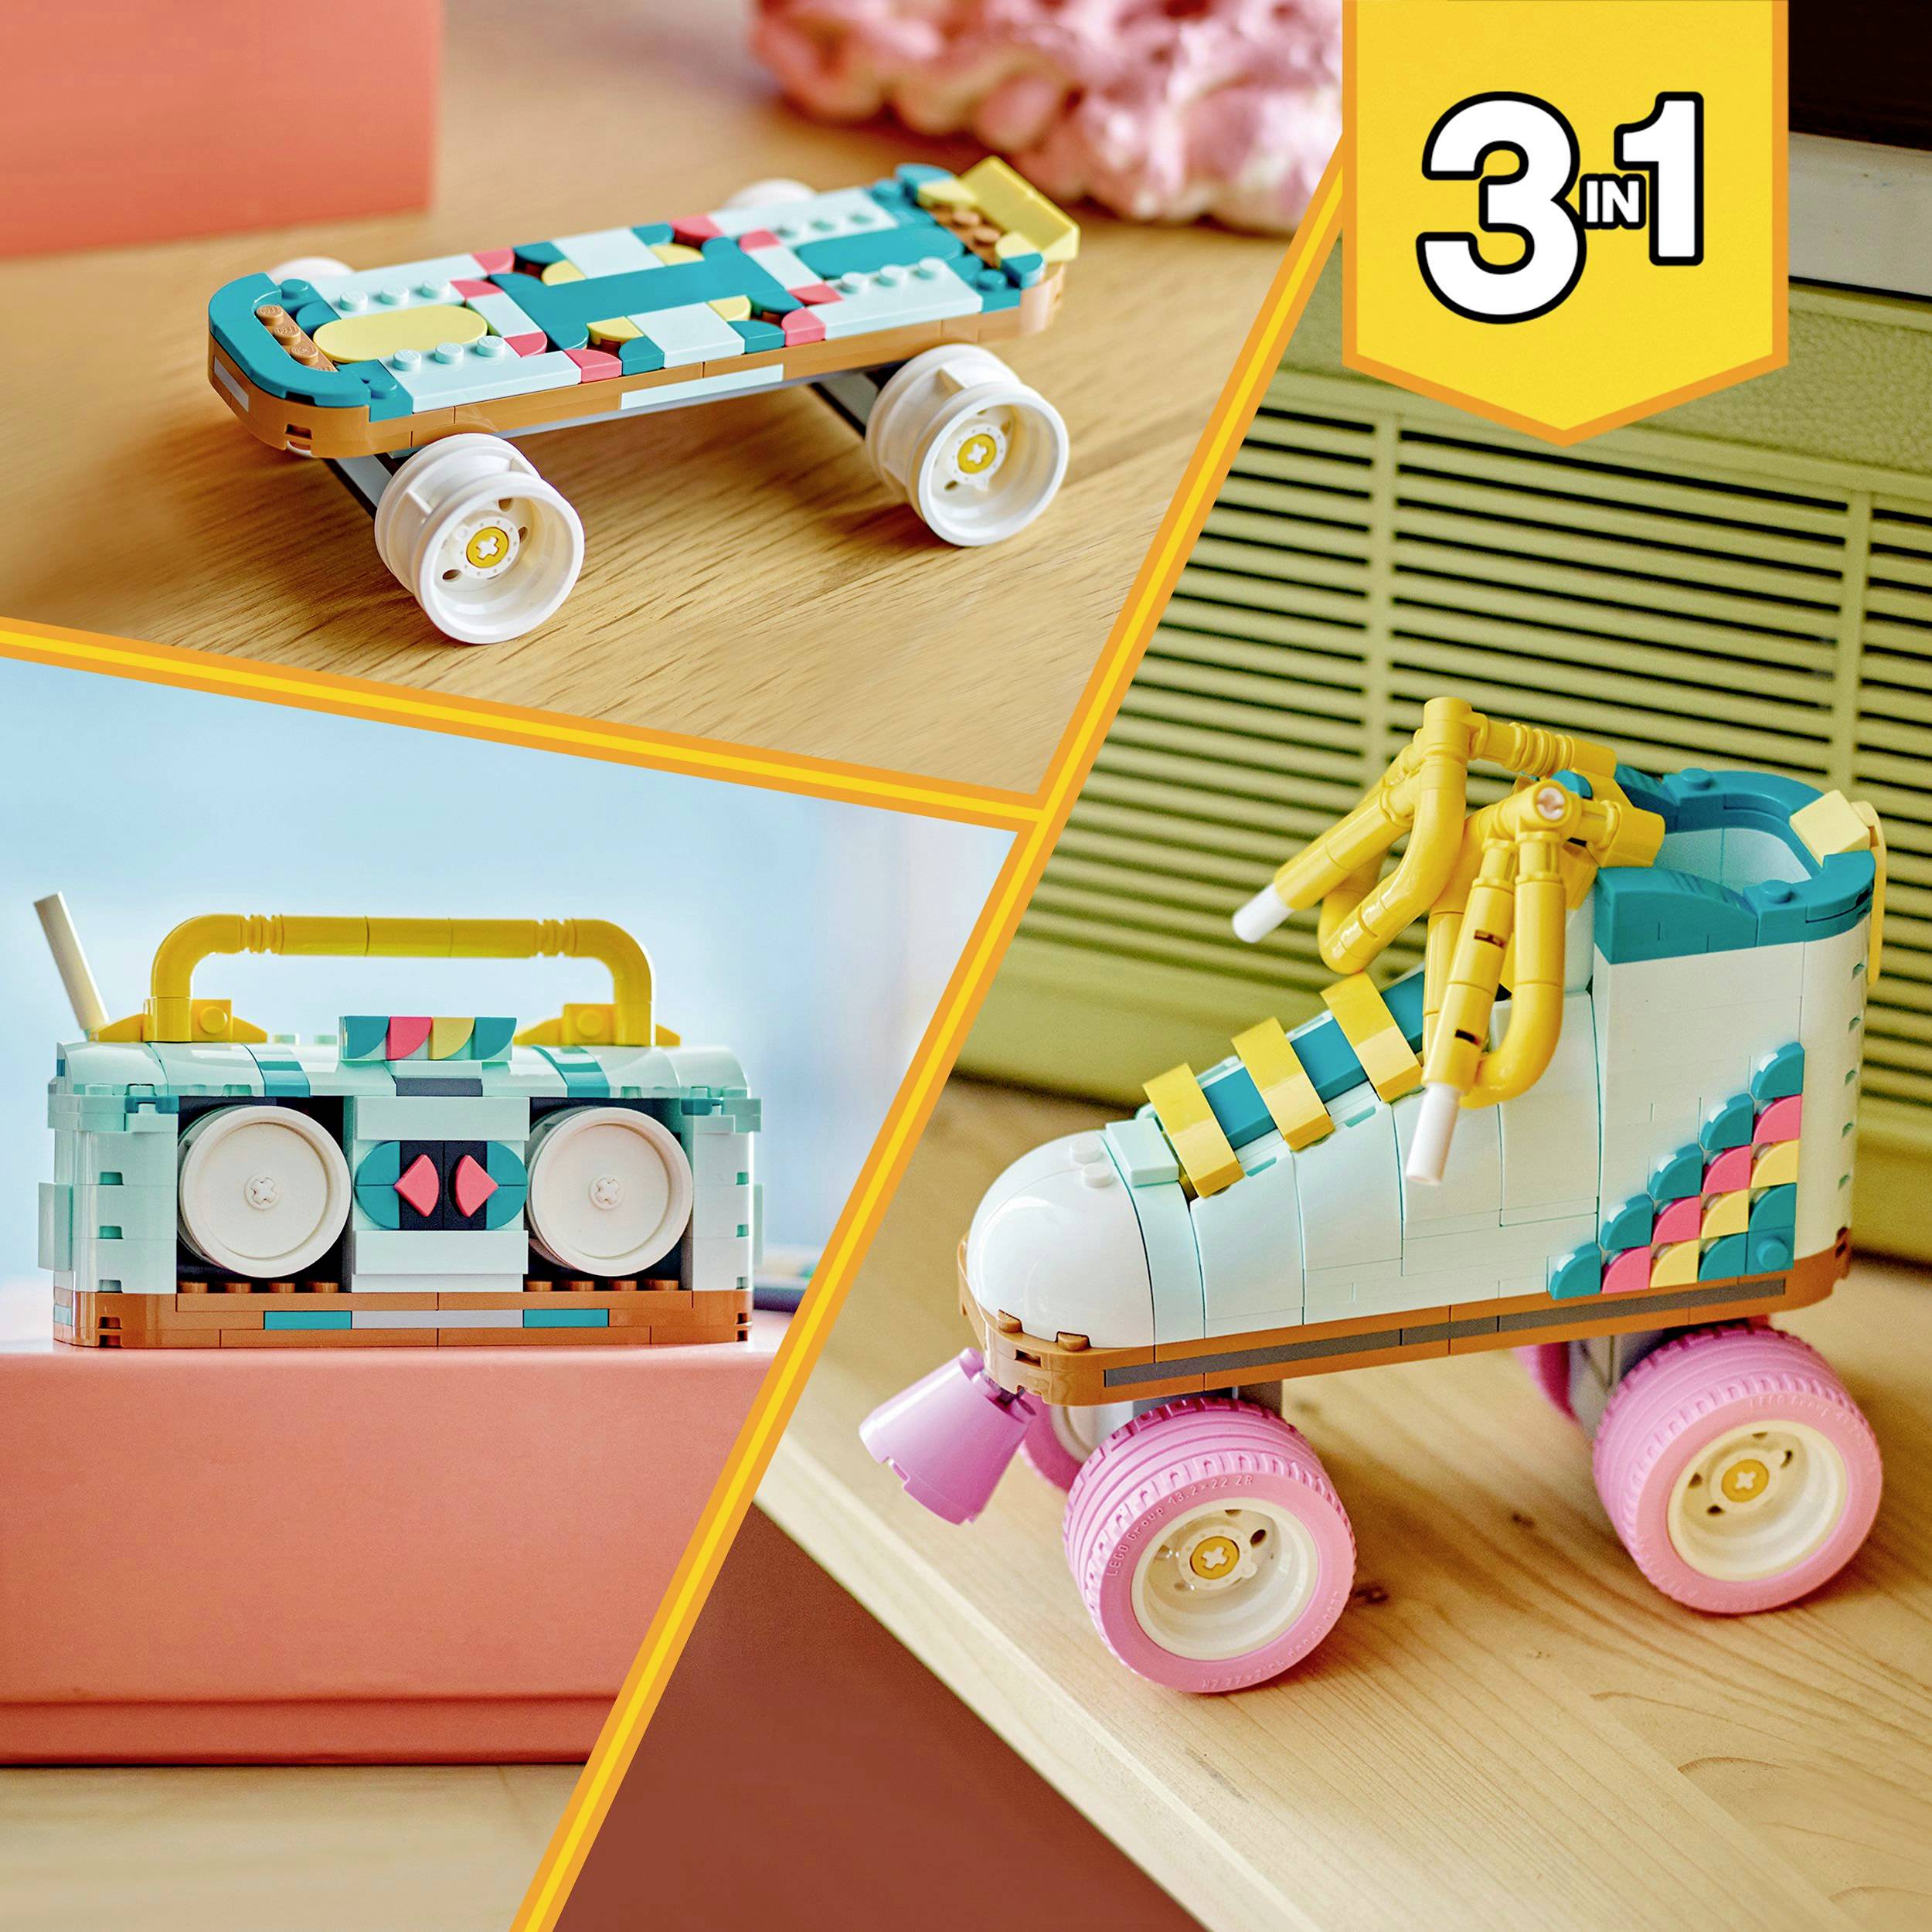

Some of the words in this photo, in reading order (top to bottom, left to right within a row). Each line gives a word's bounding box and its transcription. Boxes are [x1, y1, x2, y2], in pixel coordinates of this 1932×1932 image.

[1106, 1544, 1129, 1577] LEGO
[1126, 1506, 1165, 1541] Group
[1235, 1475, 1253, 1486] ZR
